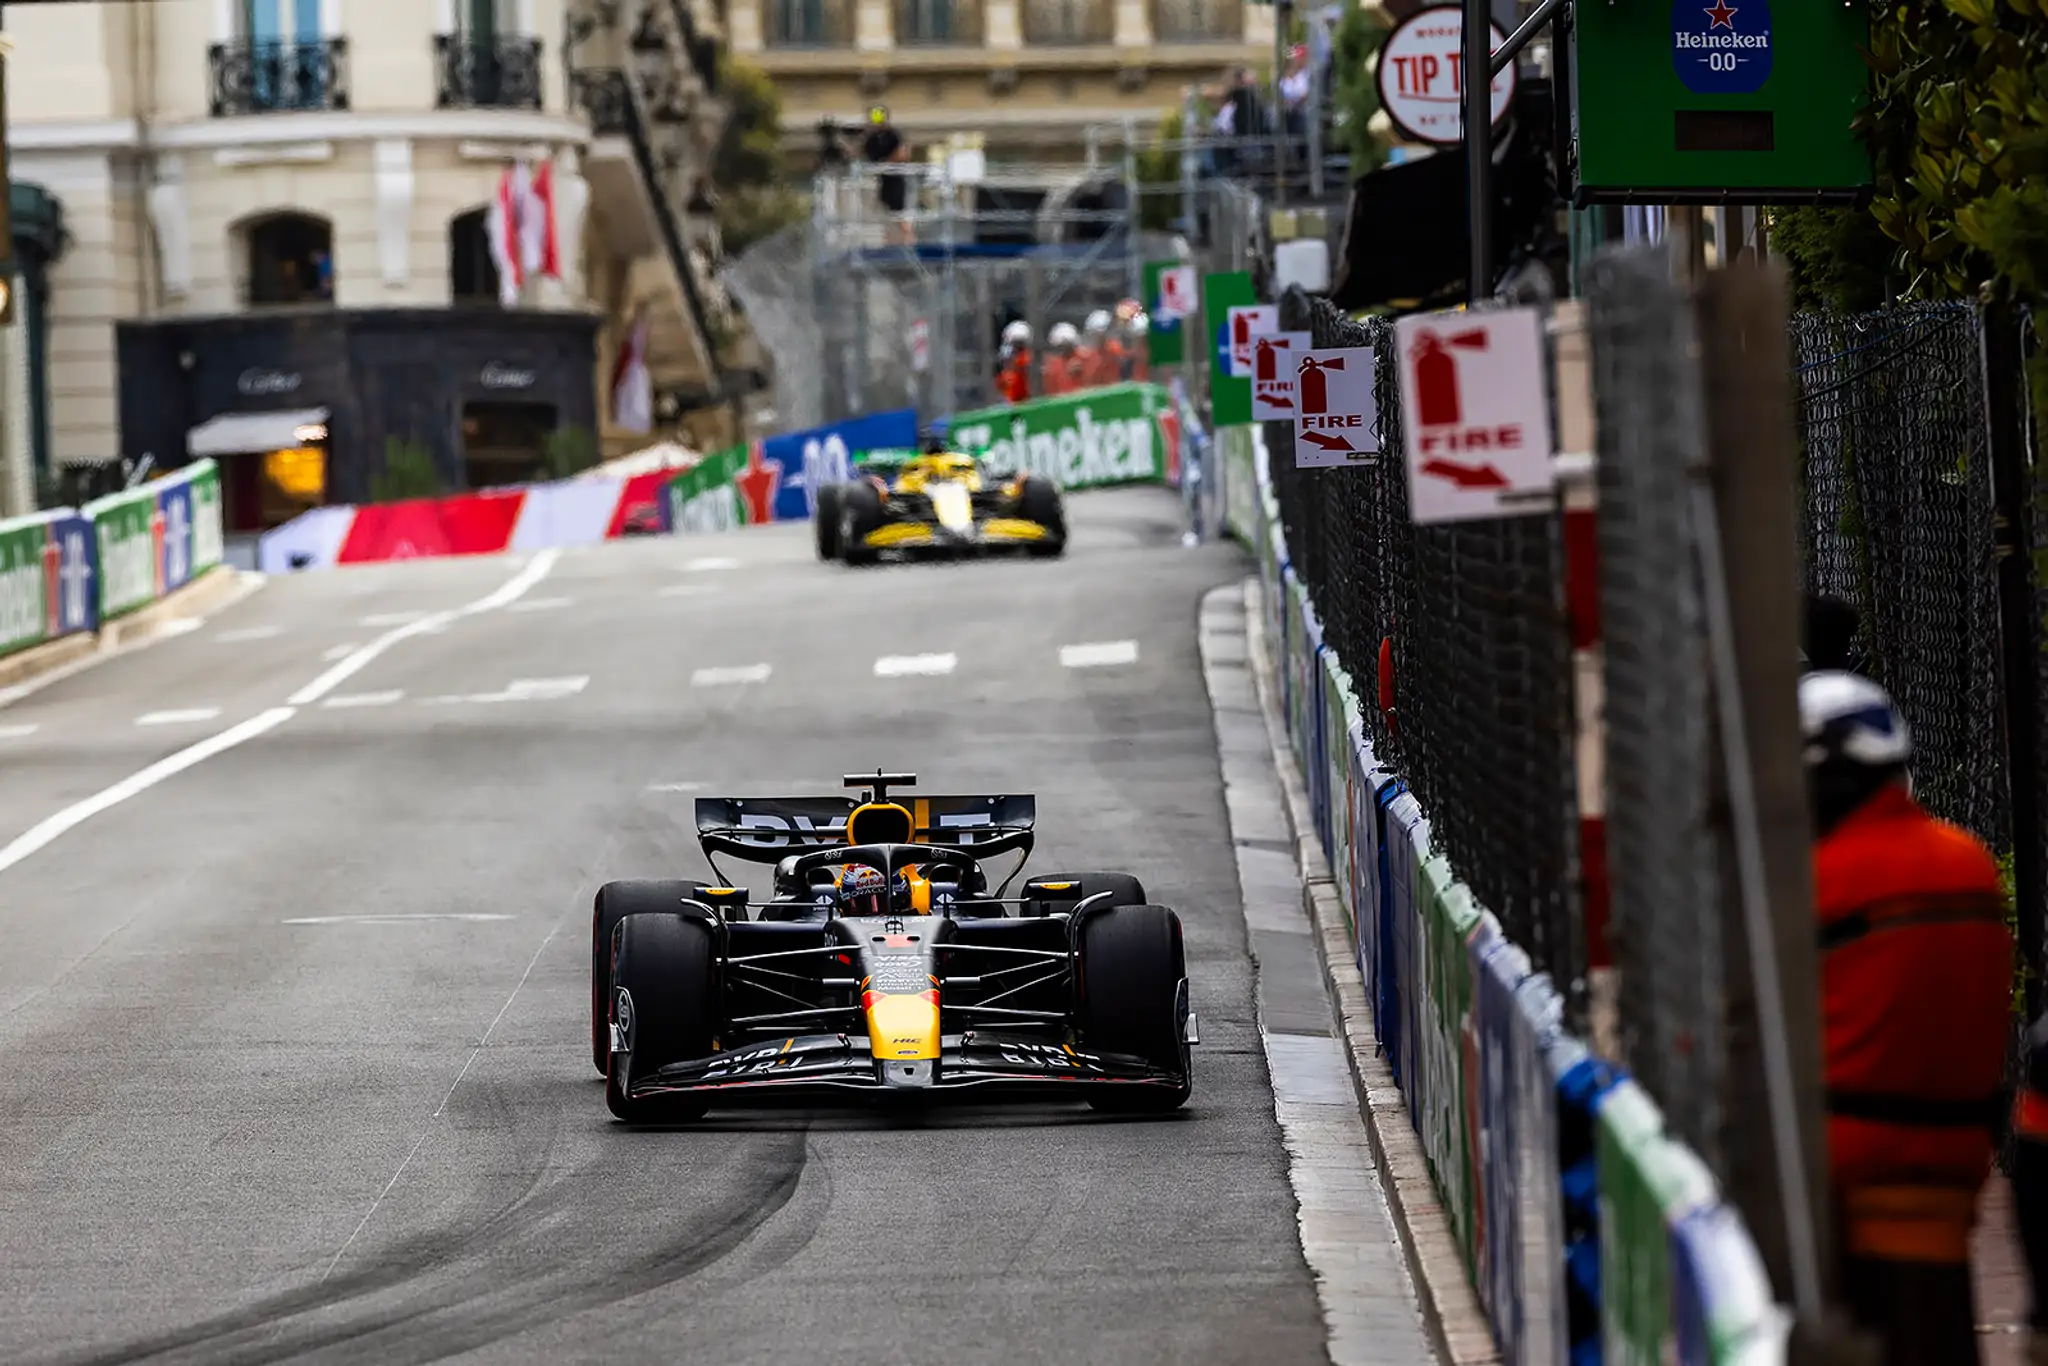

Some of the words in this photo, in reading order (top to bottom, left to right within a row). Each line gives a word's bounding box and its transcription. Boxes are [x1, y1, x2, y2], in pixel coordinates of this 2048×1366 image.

[1675, 31, 1768, 48] Heineken
[1709, 52, 1736, 71] 0.0
[1391, 55, 1438, 94] TIP
[1301, 414, 1363, 429] FIRE
[1419, 424, 1523, 454] FIRE
